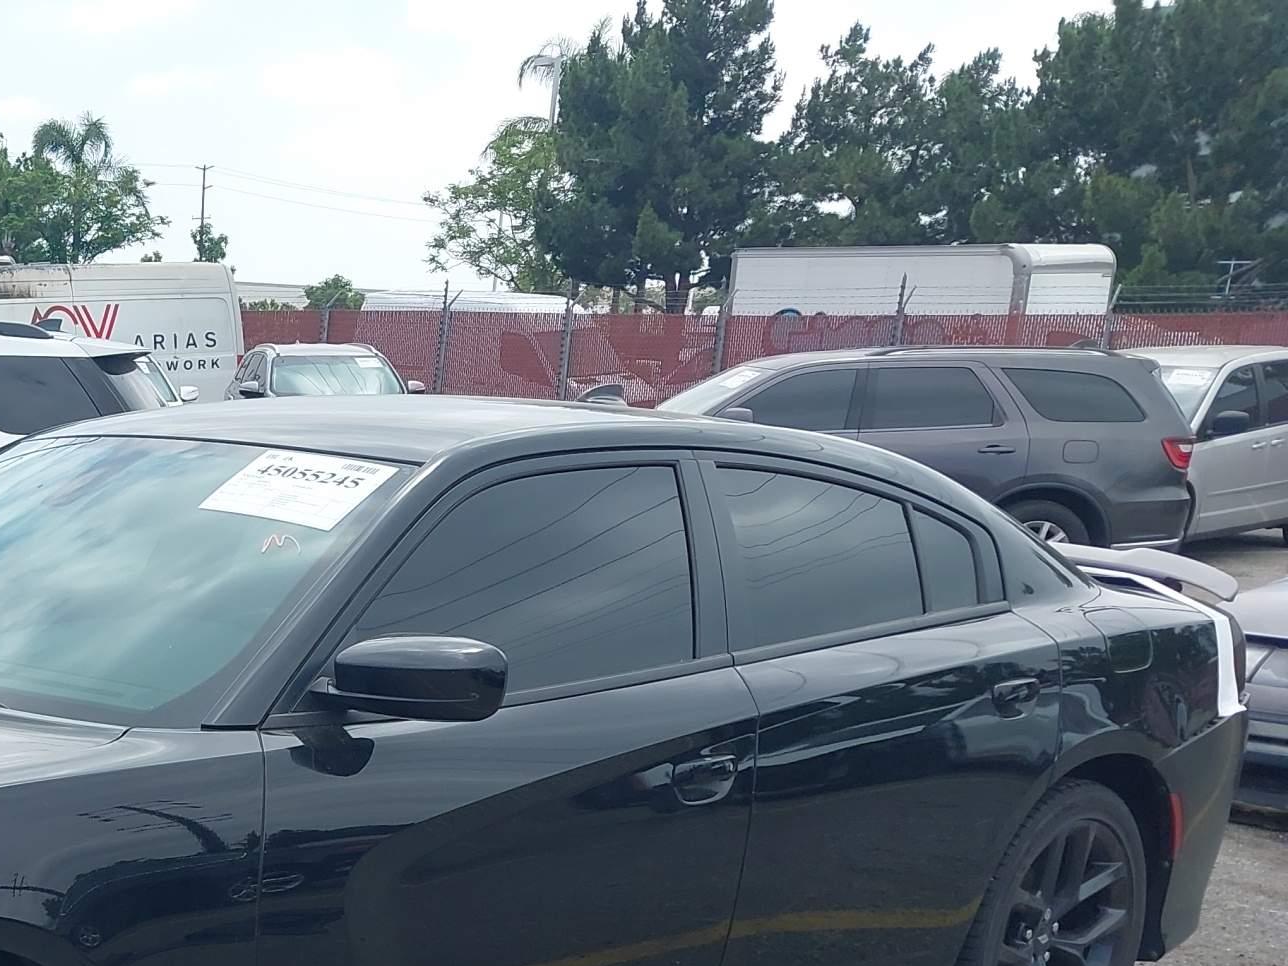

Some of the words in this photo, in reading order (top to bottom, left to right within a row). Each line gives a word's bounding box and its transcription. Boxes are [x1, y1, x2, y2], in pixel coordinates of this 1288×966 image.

[134, 331, 217, 351] ARIAS
[158, 358, 221, 371] WORK
[257, 464, 365, 489] 45055245
